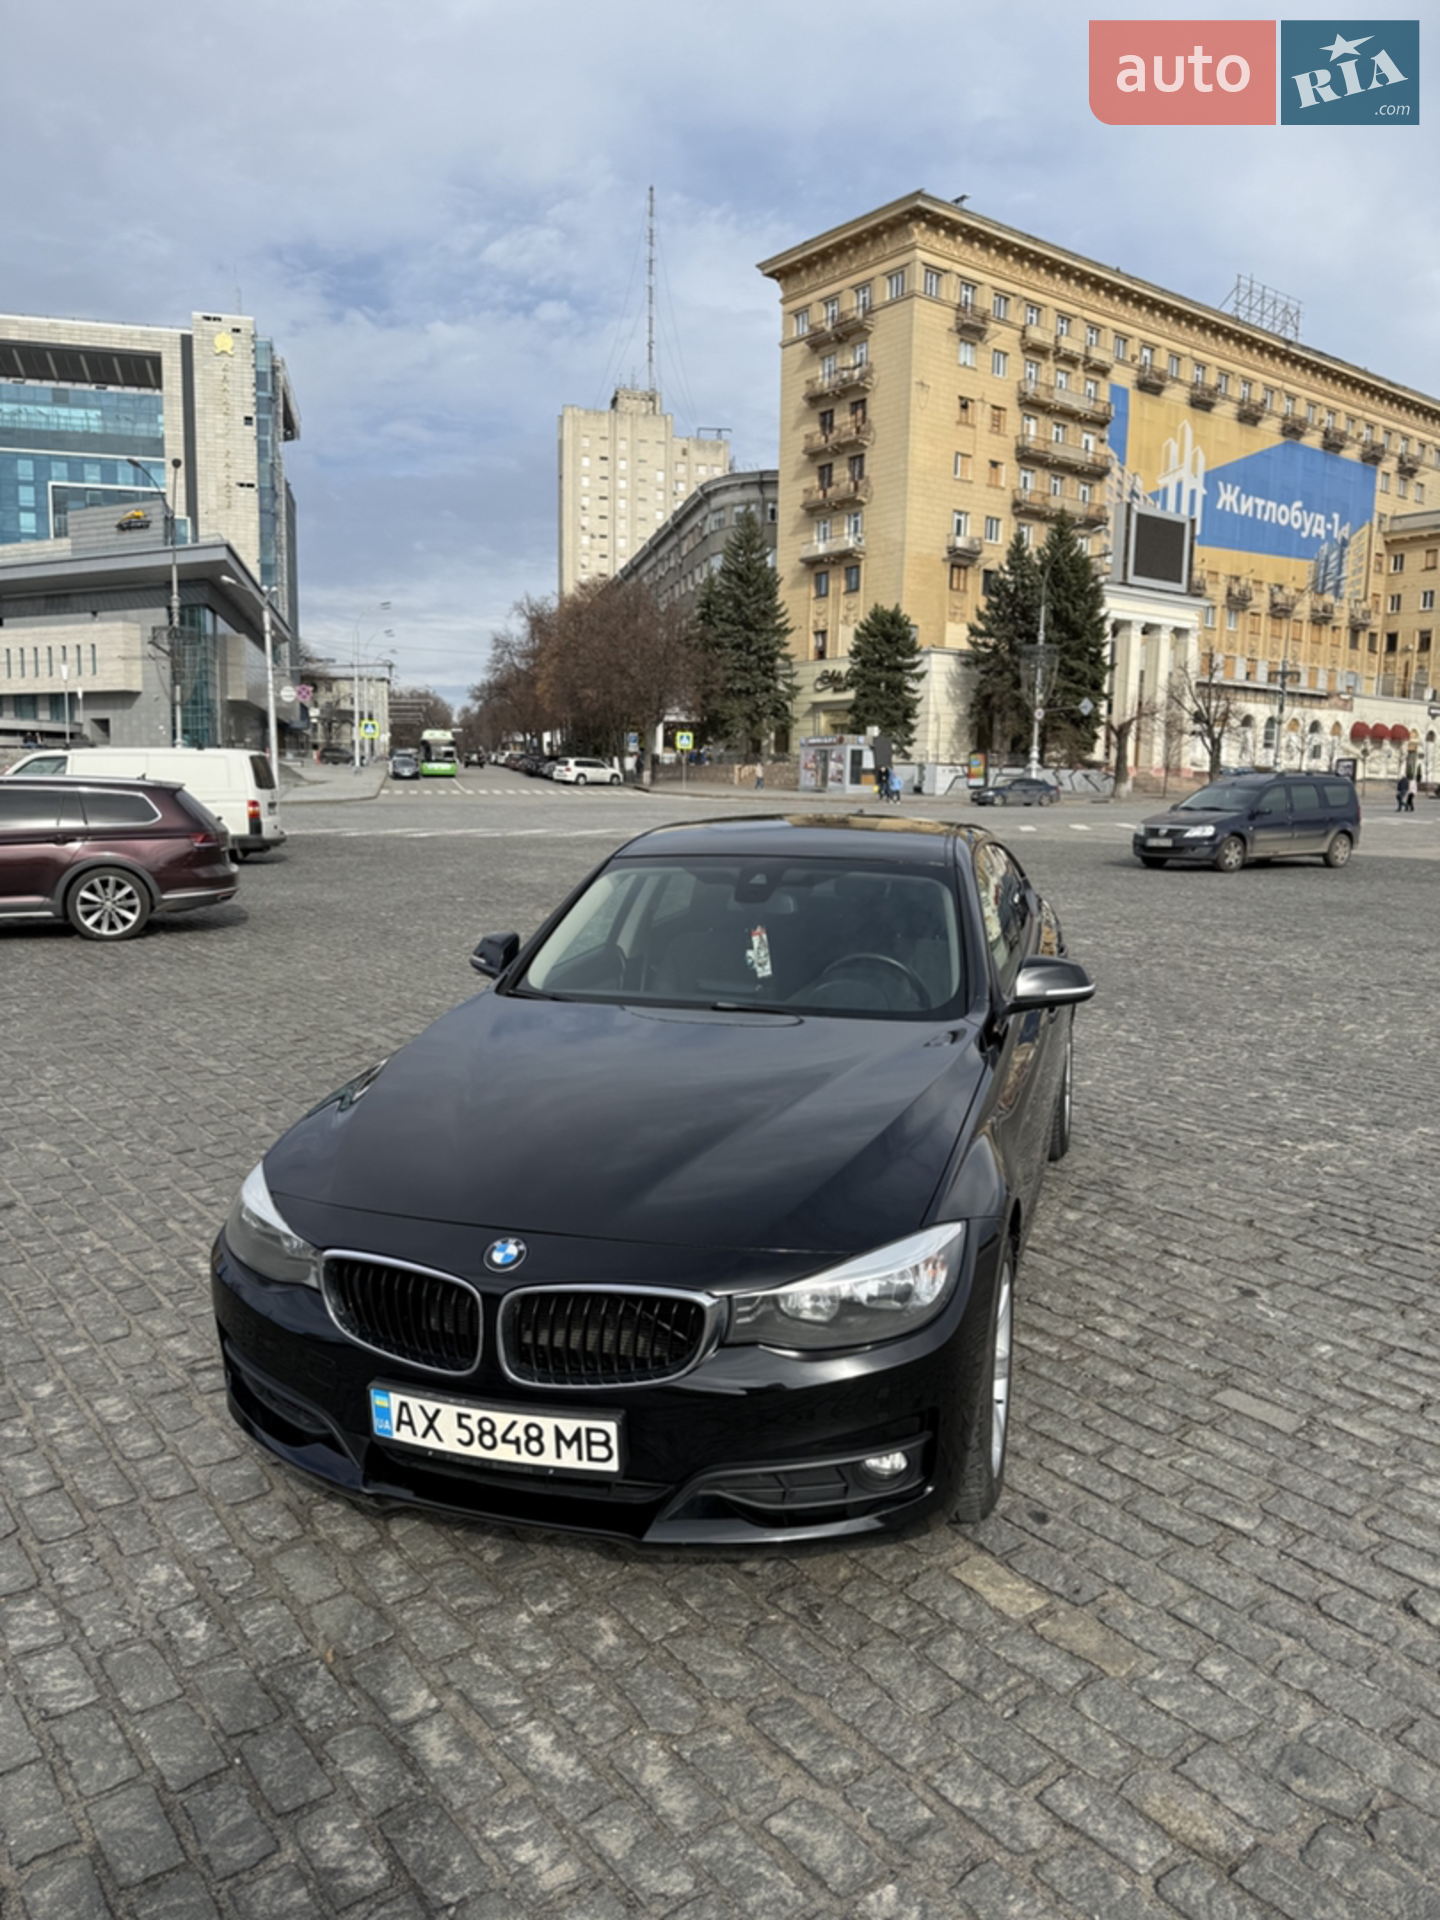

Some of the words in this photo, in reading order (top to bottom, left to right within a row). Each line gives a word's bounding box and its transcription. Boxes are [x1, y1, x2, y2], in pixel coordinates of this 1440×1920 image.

[1216, 480, 1340, 539] Житлобуд-1
[396, 1401, 444, 1443] AX
[456, 1412, 545, 1457] 5848
[554, 1424, 613, 1463] MB
